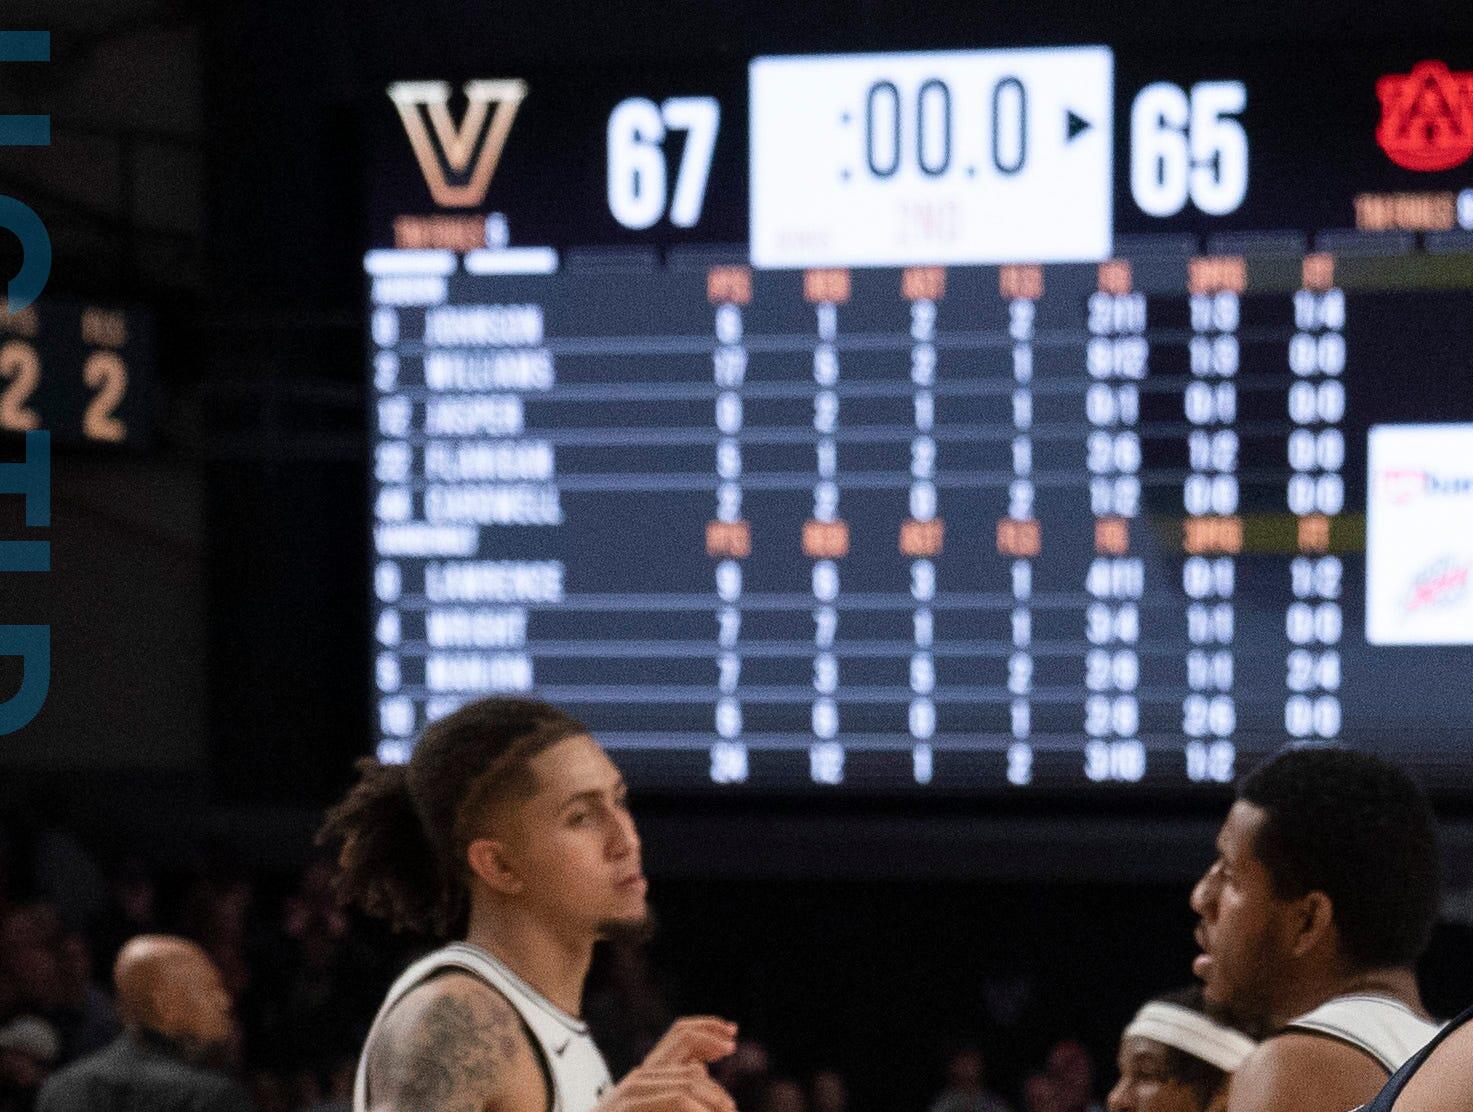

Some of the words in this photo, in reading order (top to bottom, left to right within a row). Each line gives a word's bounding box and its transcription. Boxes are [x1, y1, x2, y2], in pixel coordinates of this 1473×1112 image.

[607, 97, 721, 229] 67
[1131, 81, 1248, 216] 65
[82, 351, 129, 441] 2
